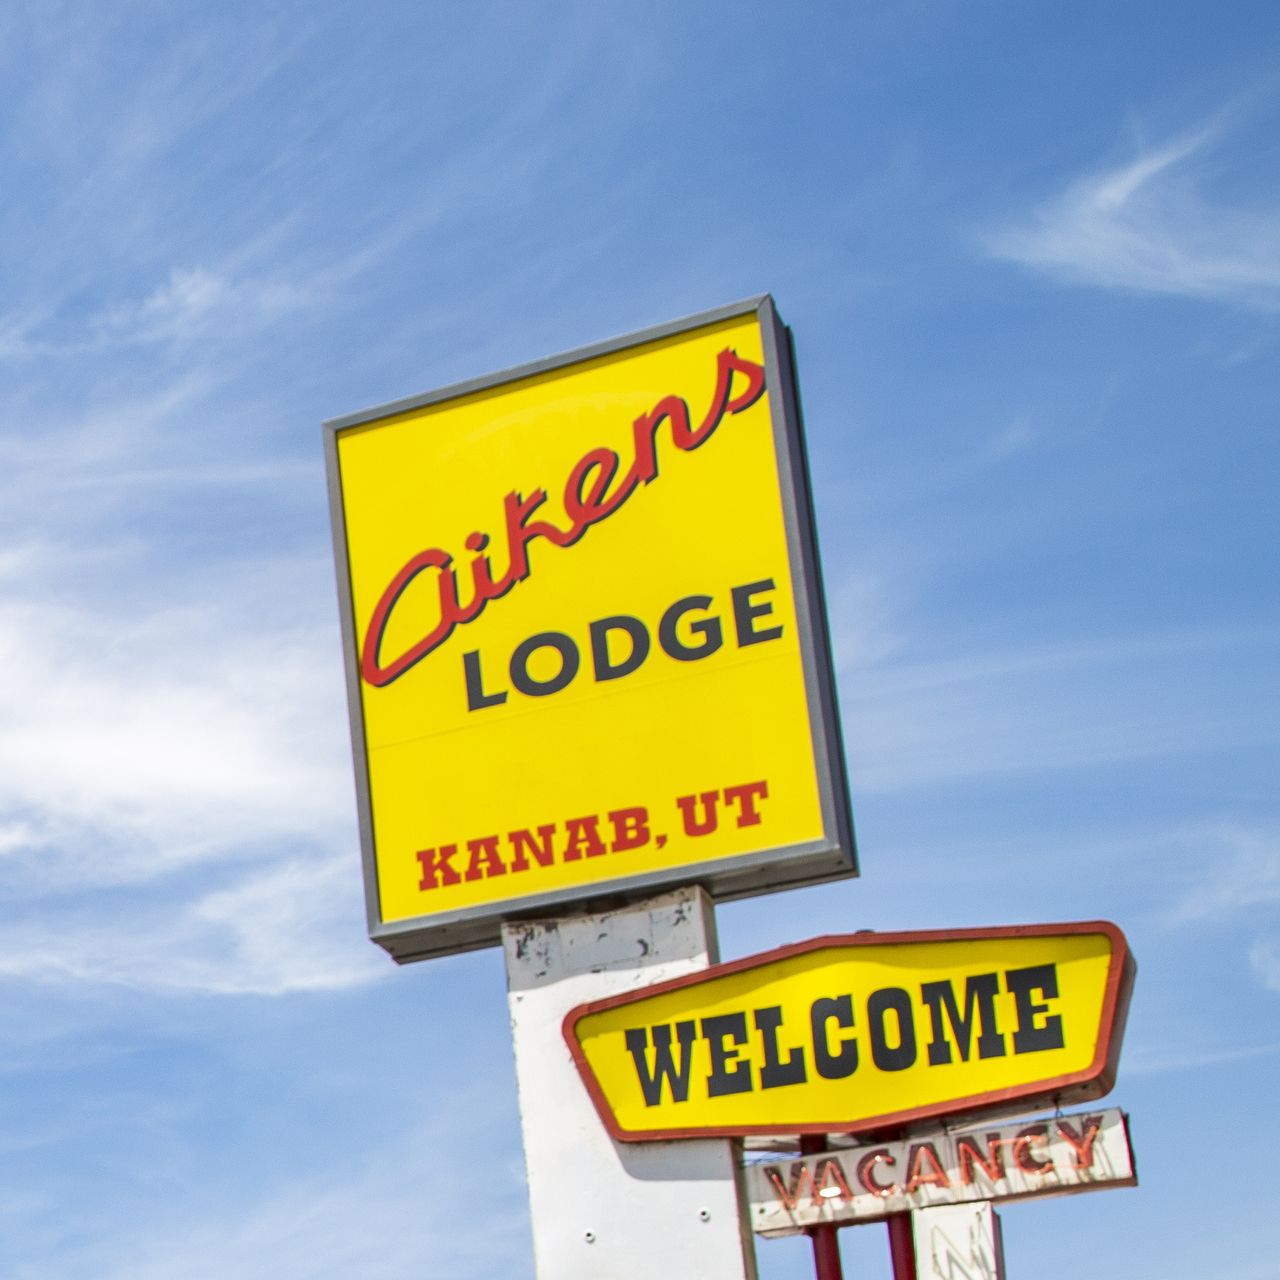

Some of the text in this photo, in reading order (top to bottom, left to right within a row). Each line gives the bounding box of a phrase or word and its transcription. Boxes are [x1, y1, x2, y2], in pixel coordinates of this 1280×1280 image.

[361, 346, 766, 688] Aikens
[461, 577, 785, 713] LODGE
[414, 779, 770, 891] KANAB, UT
[624, 962, 1066, 1108] WELCOME
[762, 1114, 1106, 1211] VACANCY
